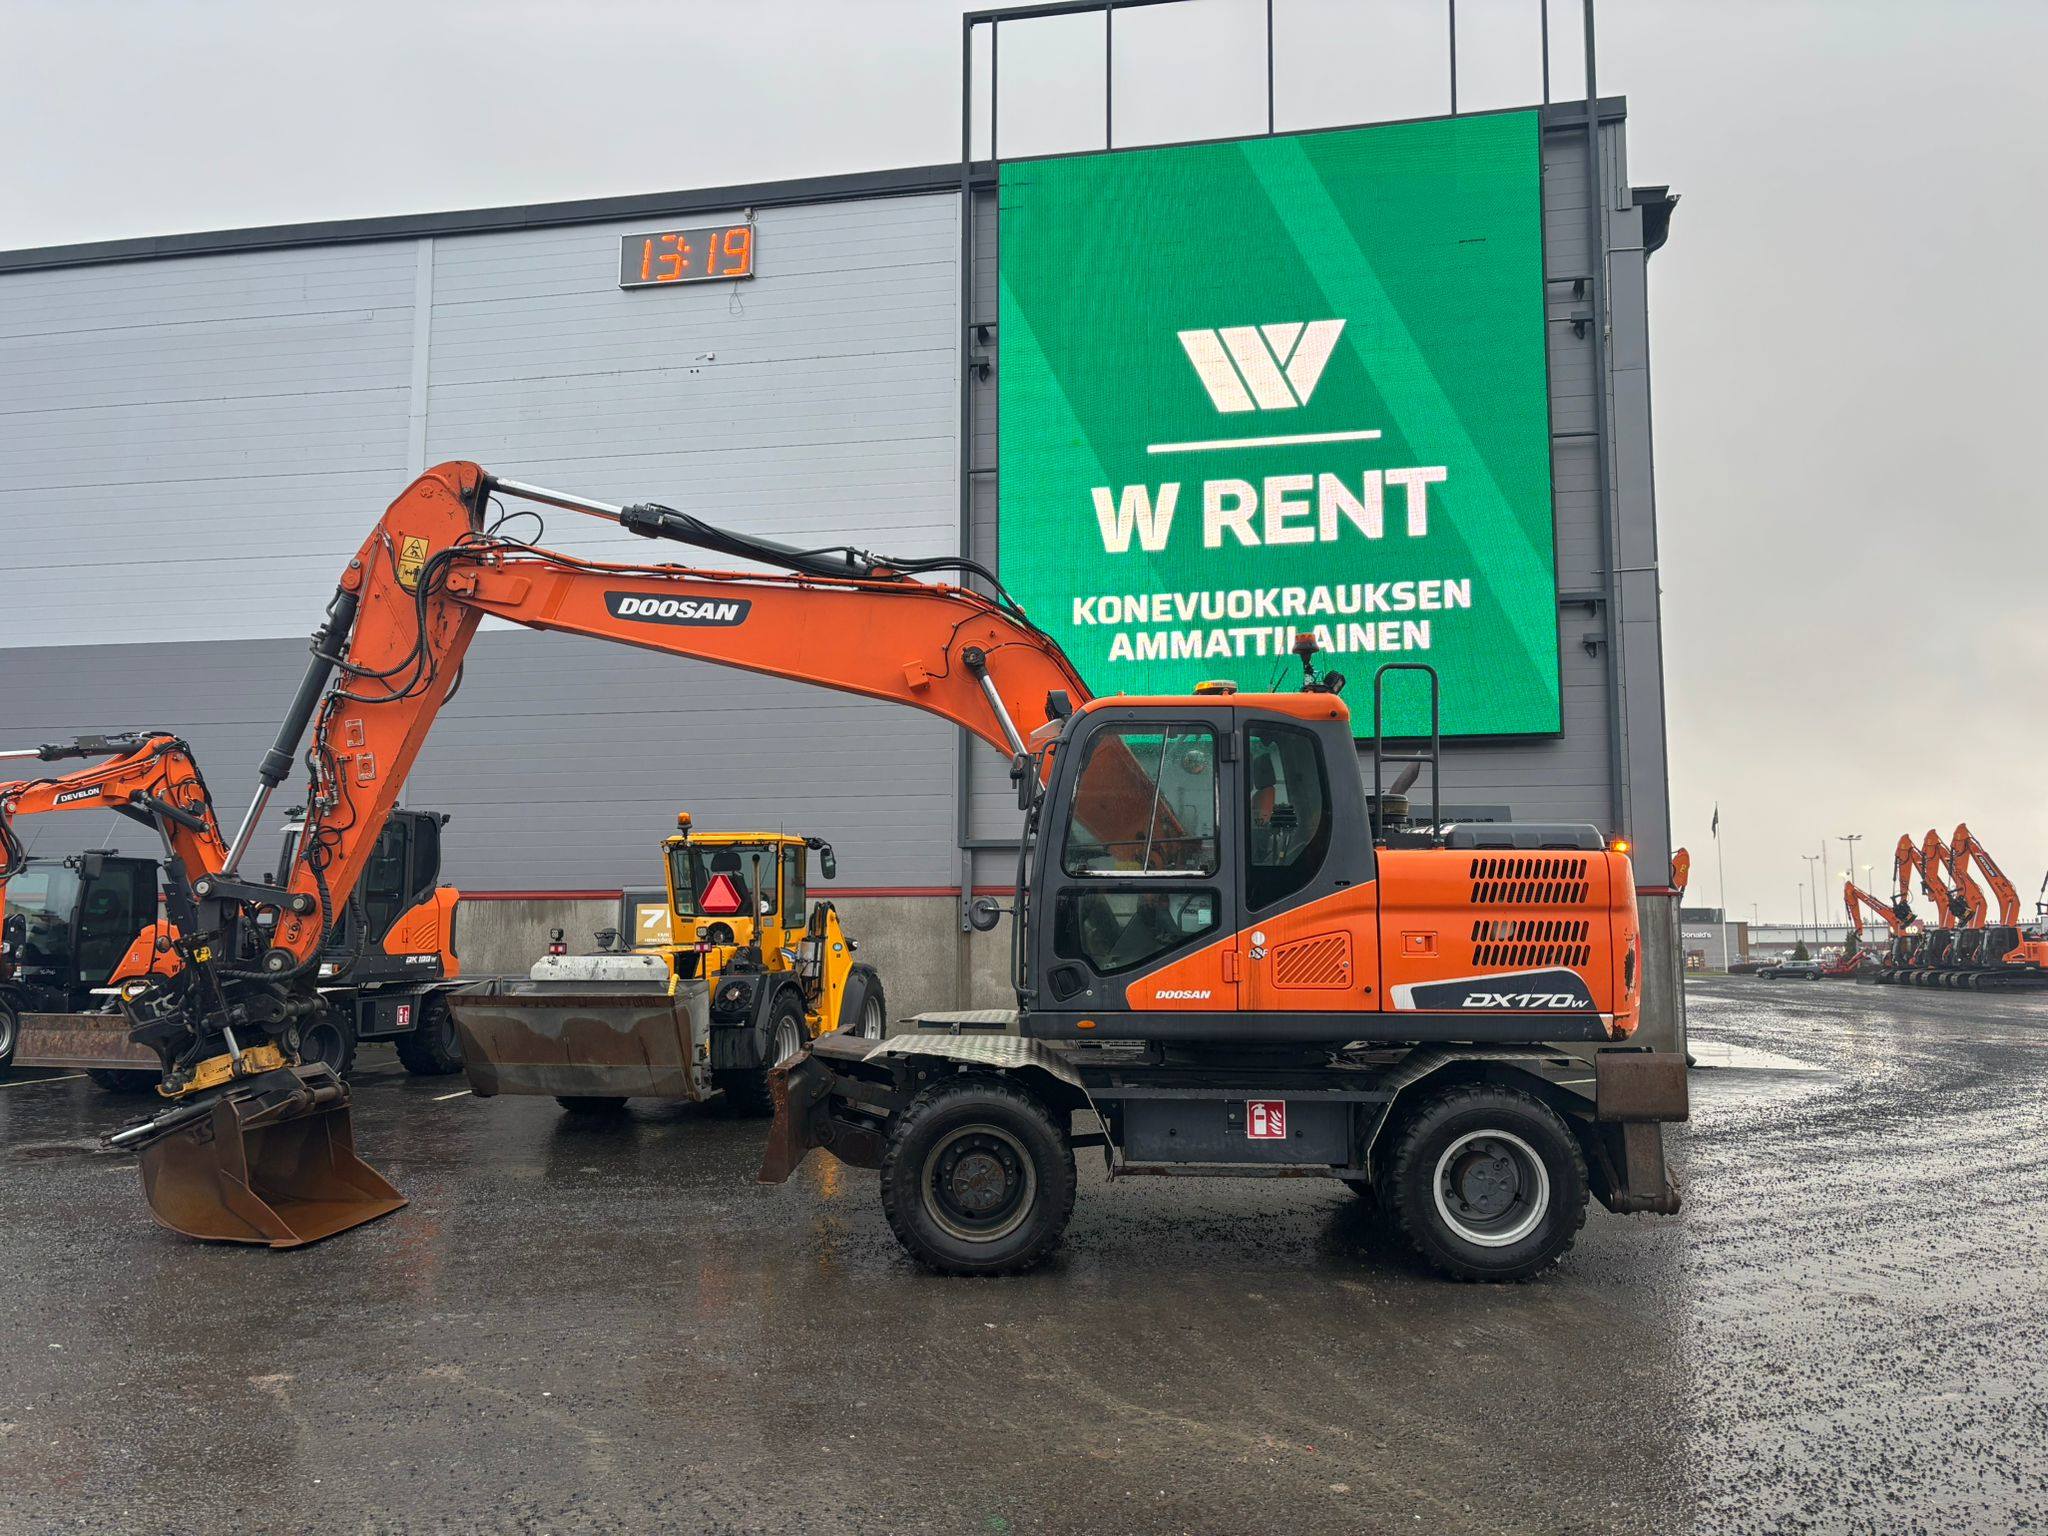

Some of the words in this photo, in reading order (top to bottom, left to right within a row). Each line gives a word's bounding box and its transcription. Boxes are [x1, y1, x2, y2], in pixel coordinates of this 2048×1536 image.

[641, 228, 750, 282] 13:19
[1091, 482, 1180, 553] W
[1204, 466, 1447, 548] RENT
[617, 597, 739, 621] DOOSAN
[1072, 579, 1471, 625] KONEVUOKRAUKSEN
[60, 787, 100, 802] DEVELON
[1155, 990, 1212, 999] DOOSAN
